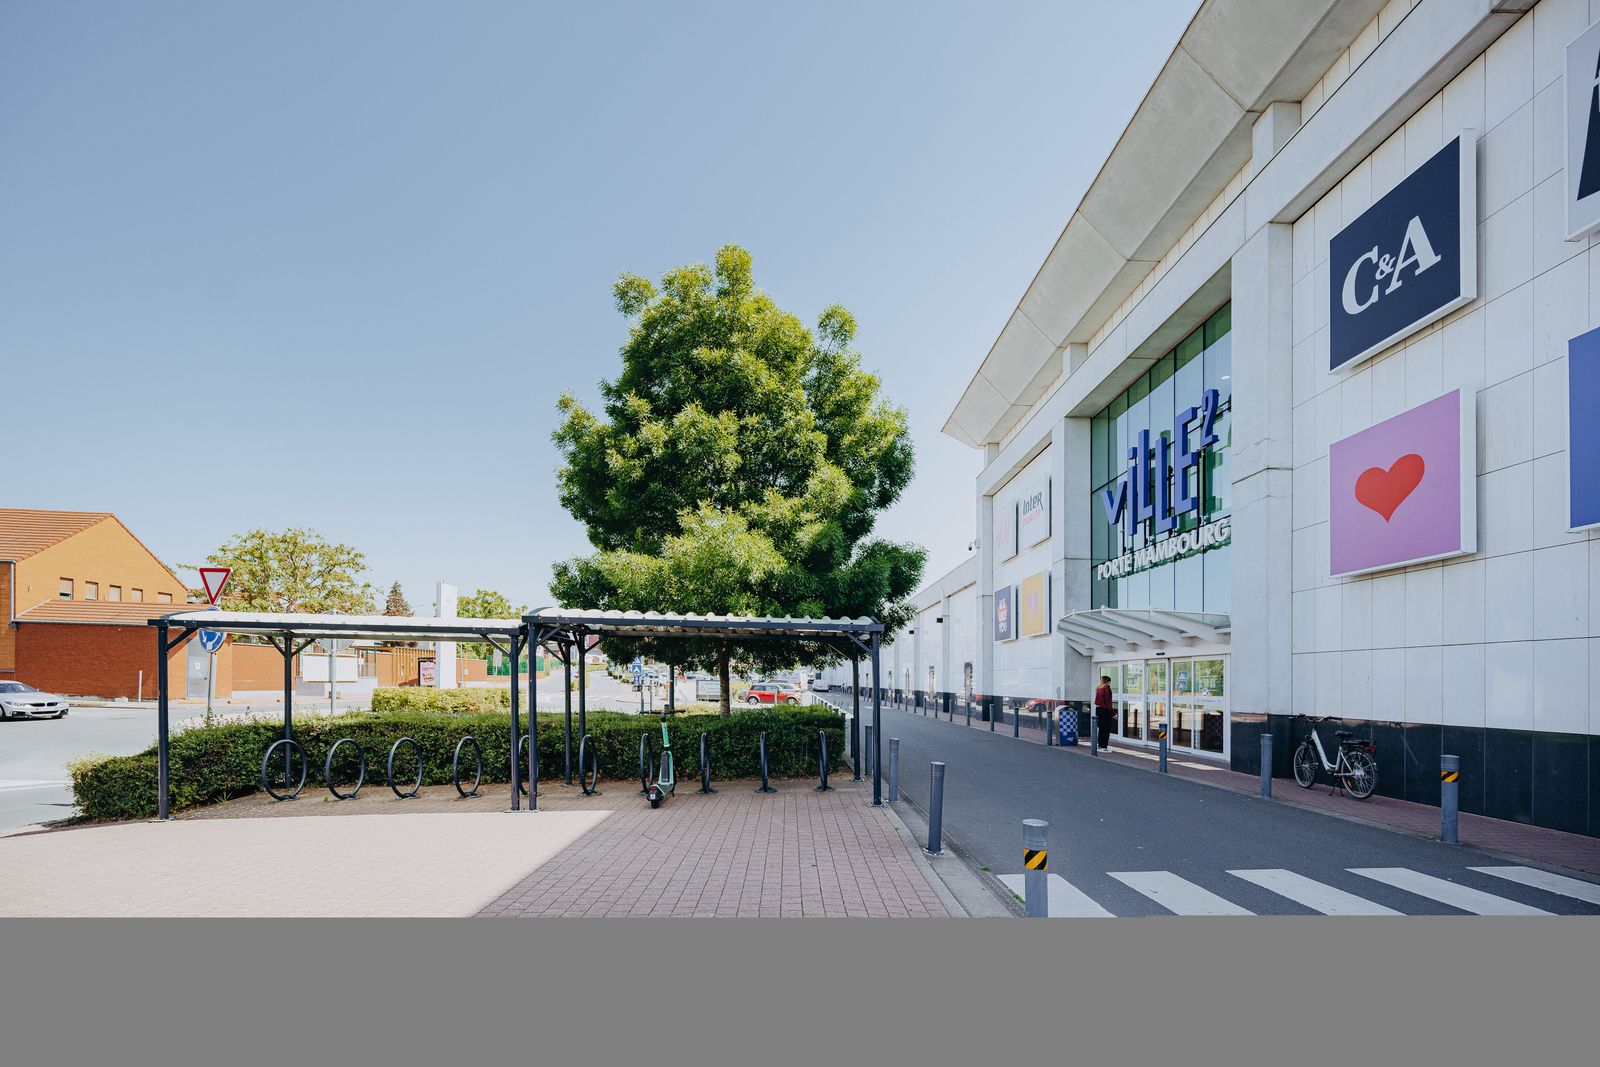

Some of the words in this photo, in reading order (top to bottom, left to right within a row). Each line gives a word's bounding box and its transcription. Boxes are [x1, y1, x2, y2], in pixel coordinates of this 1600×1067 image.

[1341, 215, 1442, 315] C&A
[1097, 553, 1132, 581] PORTE
[1133, 518, 1232, 569] MAMBOURG
